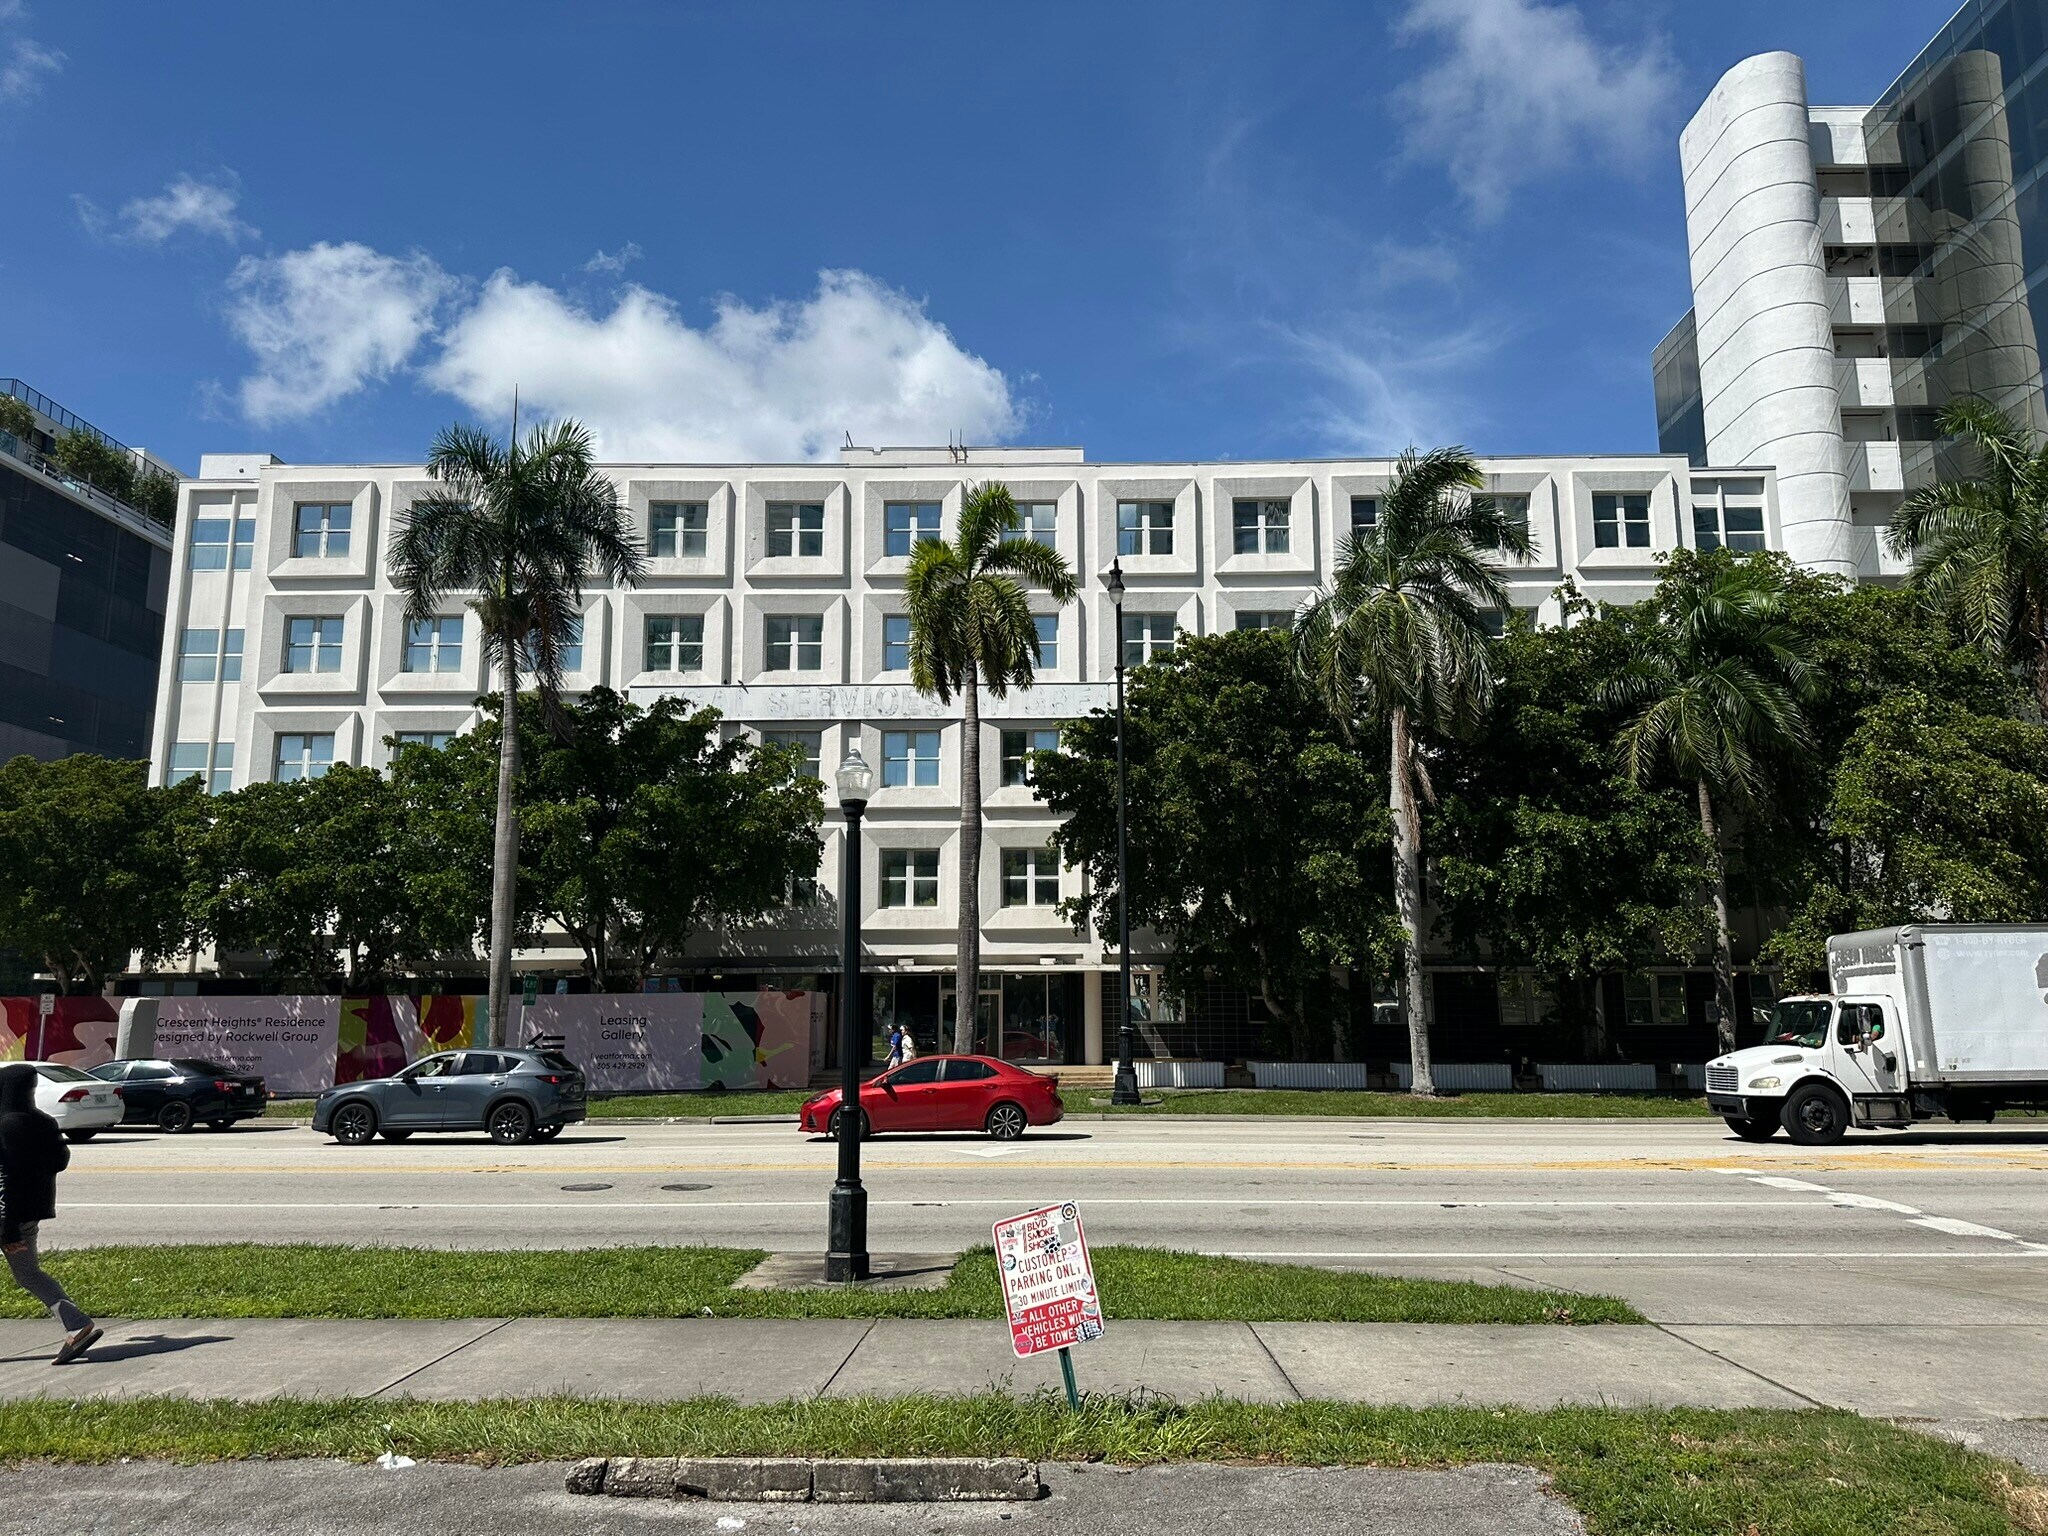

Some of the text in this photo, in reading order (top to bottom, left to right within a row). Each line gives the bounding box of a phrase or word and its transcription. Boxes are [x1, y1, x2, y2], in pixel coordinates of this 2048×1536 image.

[767, 687, 946, 717] SERVICES
[156, 1017, 208, 1028] Crescent
[265, 1016, 326, 1027] Residence
[600, 1015, 647, 1028] Leasing
[208, 1031, 223, 1044] by
[226, 1031, 279, 1042] Rockwell
[281, 1031, 319, 1044] Group
[601, 1029, 645, 1042] Gallery
[596, 1062, 610, 1070] 305
[628, 1062, 646, 1070] 2929
[1027, 1219, 1048, 1232] BLVD
[1027, 1226, 1056, 1242] SMOKE
[1028, 1238, 1048, 1252] SHO
[1010, 1269, 1053, 1293] PARKING
[1018, 1279, 1081, 1307] 30 MINUTE LIMIT
[1029, 1300, 1079, 1324] ALL OTHER
[1021, 1316, 1066, 1337] VEHICLES
[1035, 1334, 1048, 1349] BE
[1050, 1327, 1078, 1345] TOWE
